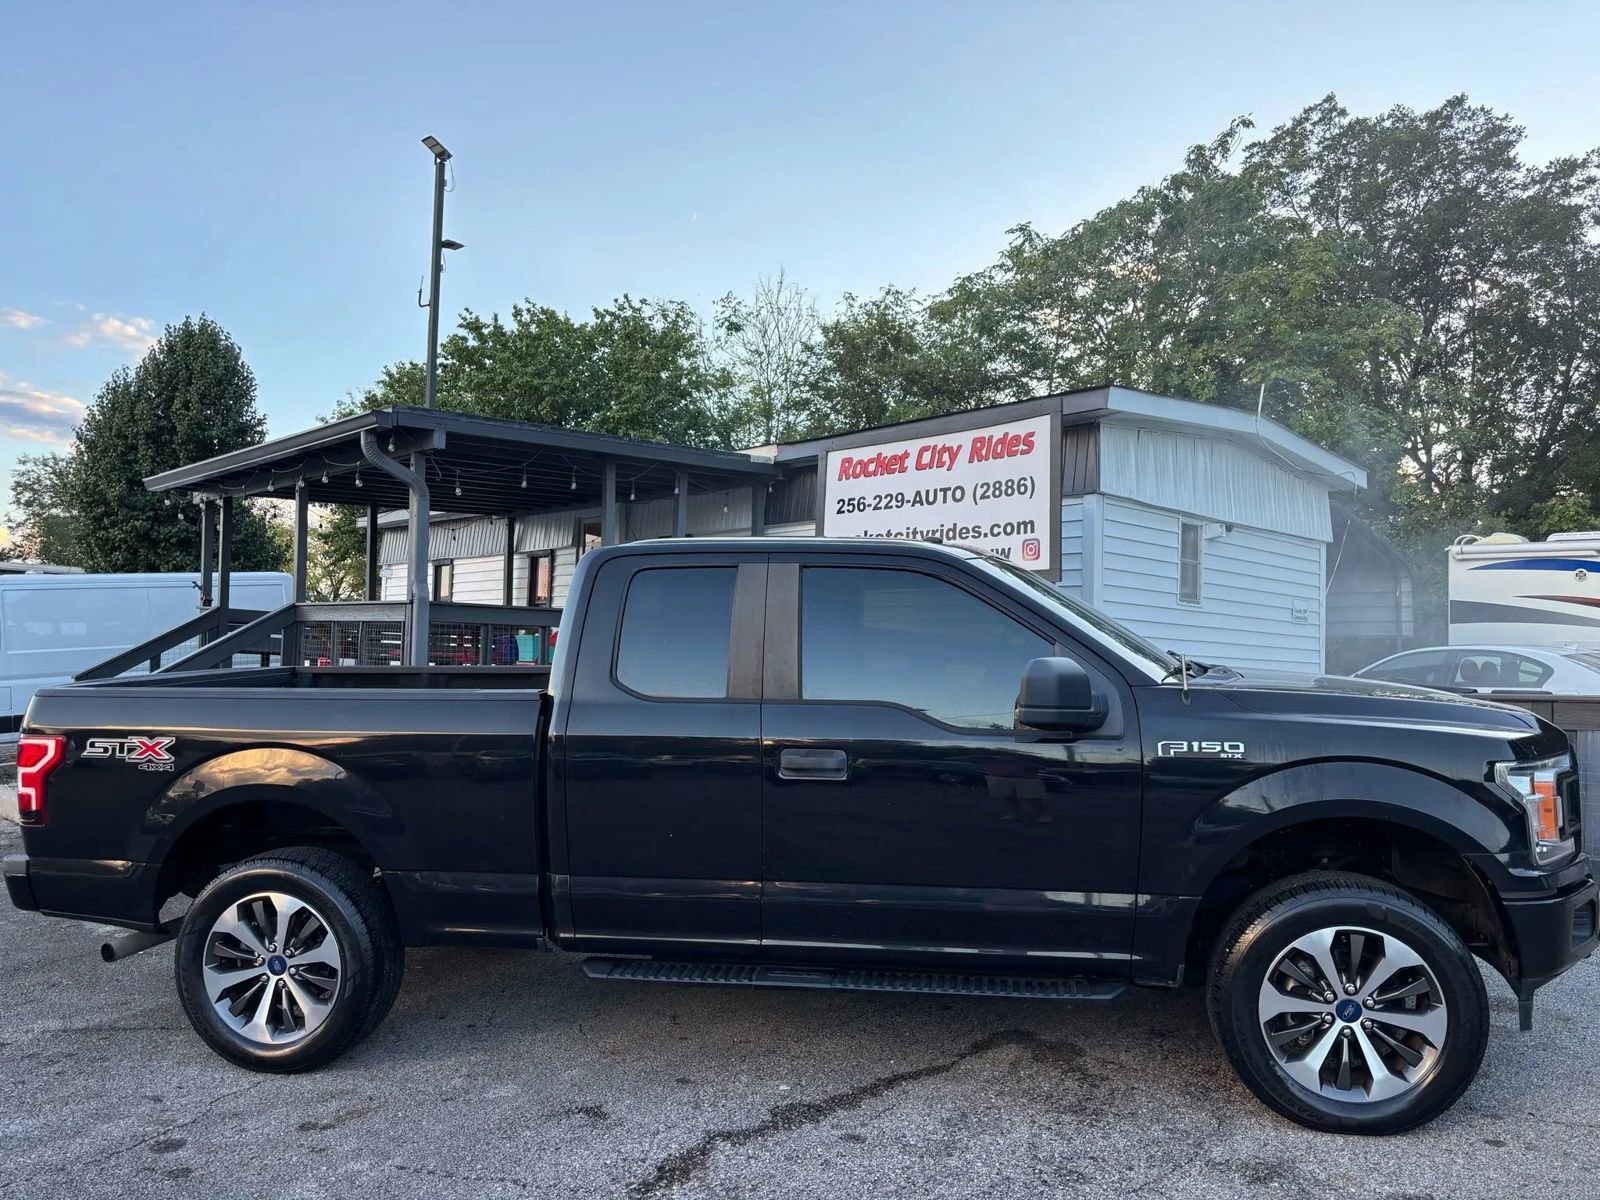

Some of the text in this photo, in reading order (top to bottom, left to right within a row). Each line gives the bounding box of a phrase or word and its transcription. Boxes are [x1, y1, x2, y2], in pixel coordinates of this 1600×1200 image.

[838, 431, 1036, 481] Rocket City Rides
[836, 475, 1036, 515] 256-229-AUTO (2886)
[81, 736, 176, 763] STX
[1157, 740, 1245, 758] F150
